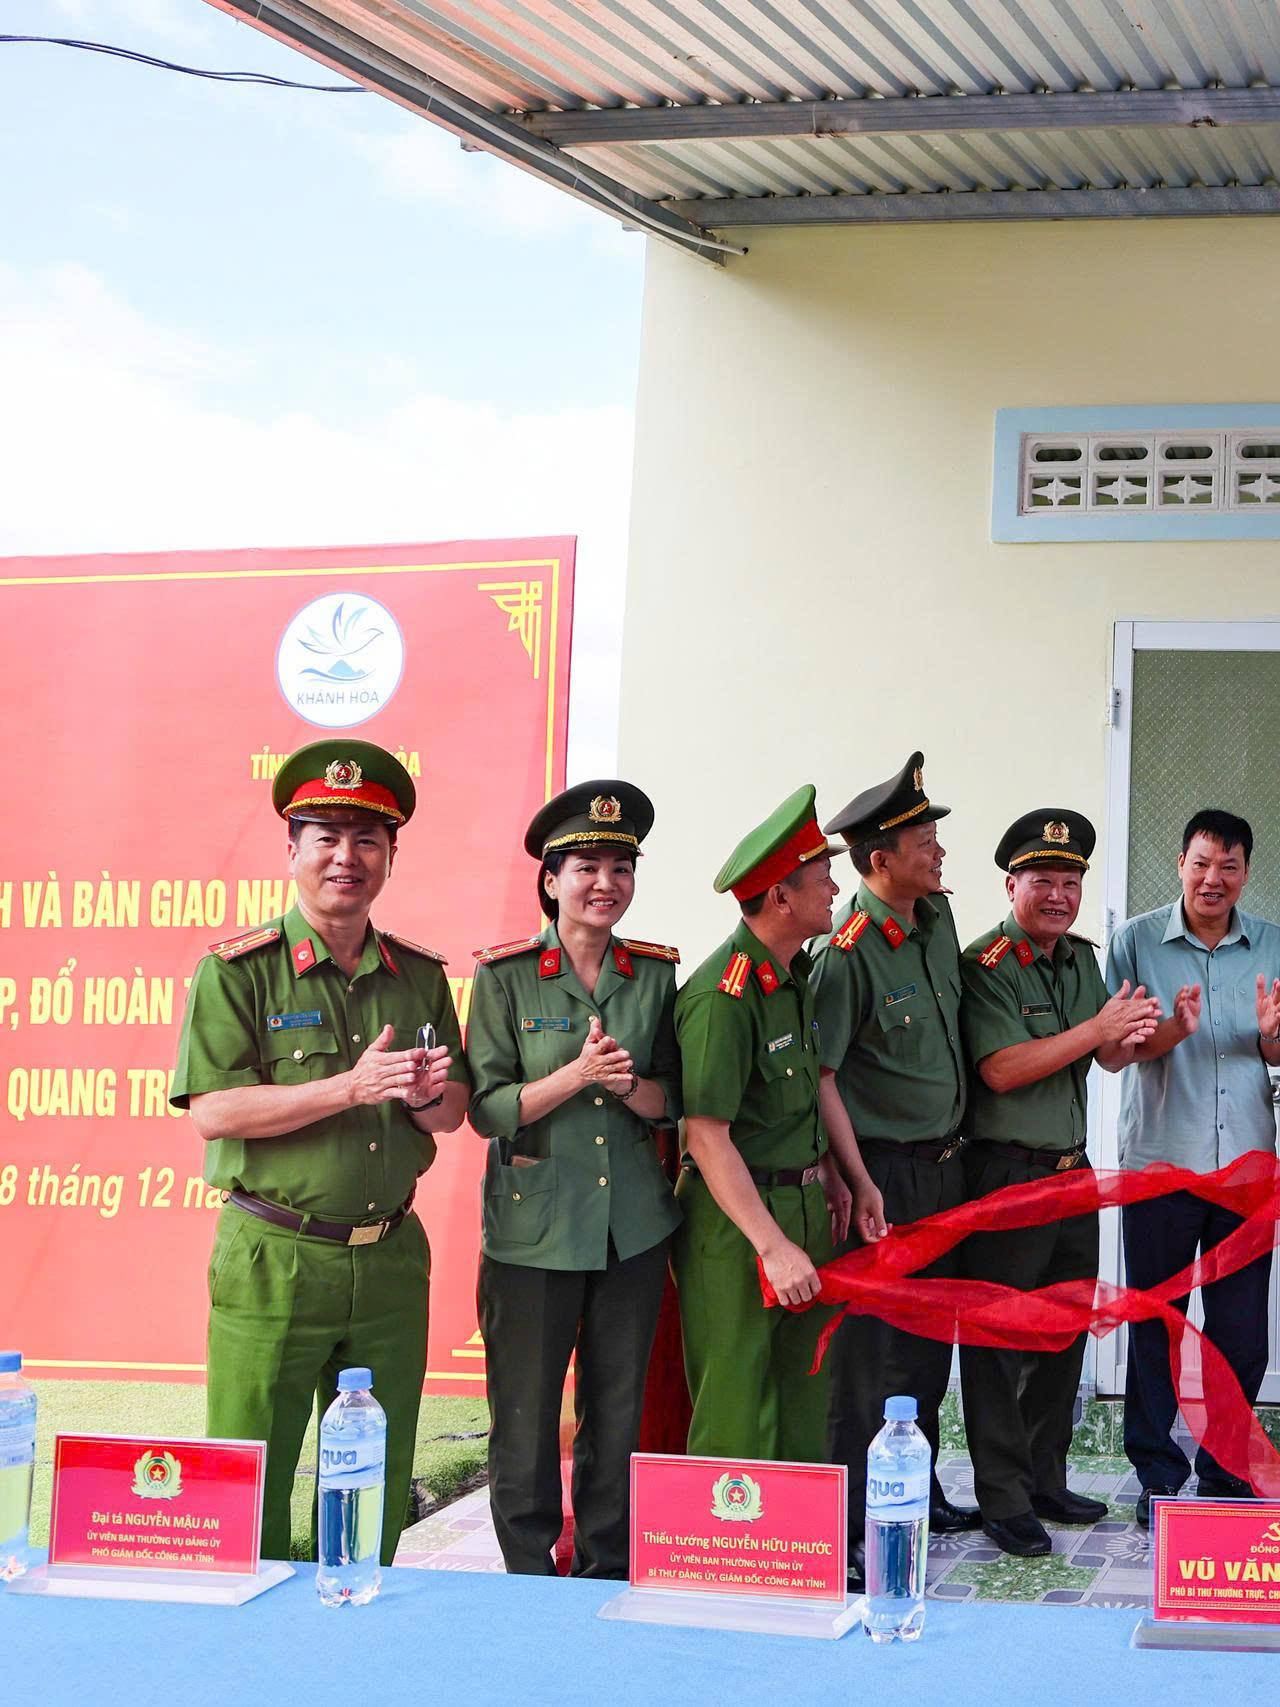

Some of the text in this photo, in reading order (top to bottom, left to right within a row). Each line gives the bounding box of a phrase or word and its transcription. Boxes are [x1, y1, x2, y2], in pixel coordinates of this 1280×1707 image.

[297, 687, 379, 704] KHÁNH HÒA
[22, 870, 62, 928] VÀ
[72, 870, 141, 928] BÀN
[150, 879, 226, 928] GIAO
[29, 957, 77, 1025] ĐỔ
[83, 966, 174, 1025] HOÀN
[7, 1067, 117, 1121] QUANG
[27, 1163, 124, 1218] tháng
[137, 1166, 175, 1208] 12
[92, 1511, 219, 1531] Đại tá NGUYỄN MẬU AN
[100, 1532, 117, 1542] VIÊN
[119, 1534, 135, 1543] BAN
[137, 1533, 171, 1545] THƯỜNG
[173, 1537, 184, 1547] VỤ
[642, 1531, 832, 1555] Thiếu tướng NGUYỄN HỮU PHƯỚC
[1250, 1542, 1279, 1554] ĐỒNG
[91, 1547, 109, 1557] PHÓ
[111, 1547, 133, 1559] GIÁM
[135, 1548, 153, 1560] ĐỐC
[154, 1549, 178, 1561] CÔNG
[180, 1554, 192, 1562] AN
[682, 1553, 700, 1564] VIÊN
[702, 1557, 719, 1565] BAN
[721, 1556, 756, 1568] THƯỜNG
[758, 1560, 769, 1570] VỤ
[648, 1567, 656, 1577] BÍ
[658, 1569, 677, 1579] THƯ
[679, 1568, 702, 1580] ĐẢNG
[719, 1571, 742, 1583] GIÁM
[745, 1573, 763, 1584] ĐỐC
[765, 1574, 789, 1586] CÔNG
[791, 1578, 803, 1588] AN
[1179, 1557, 1215, 1580] VŨ
[1170, 1584, 1185, 1597] PHÓ
[1197, 1587, 1213, 1597] THƯ
[1214, 1586, 1244, 1599] THƯỜNG
